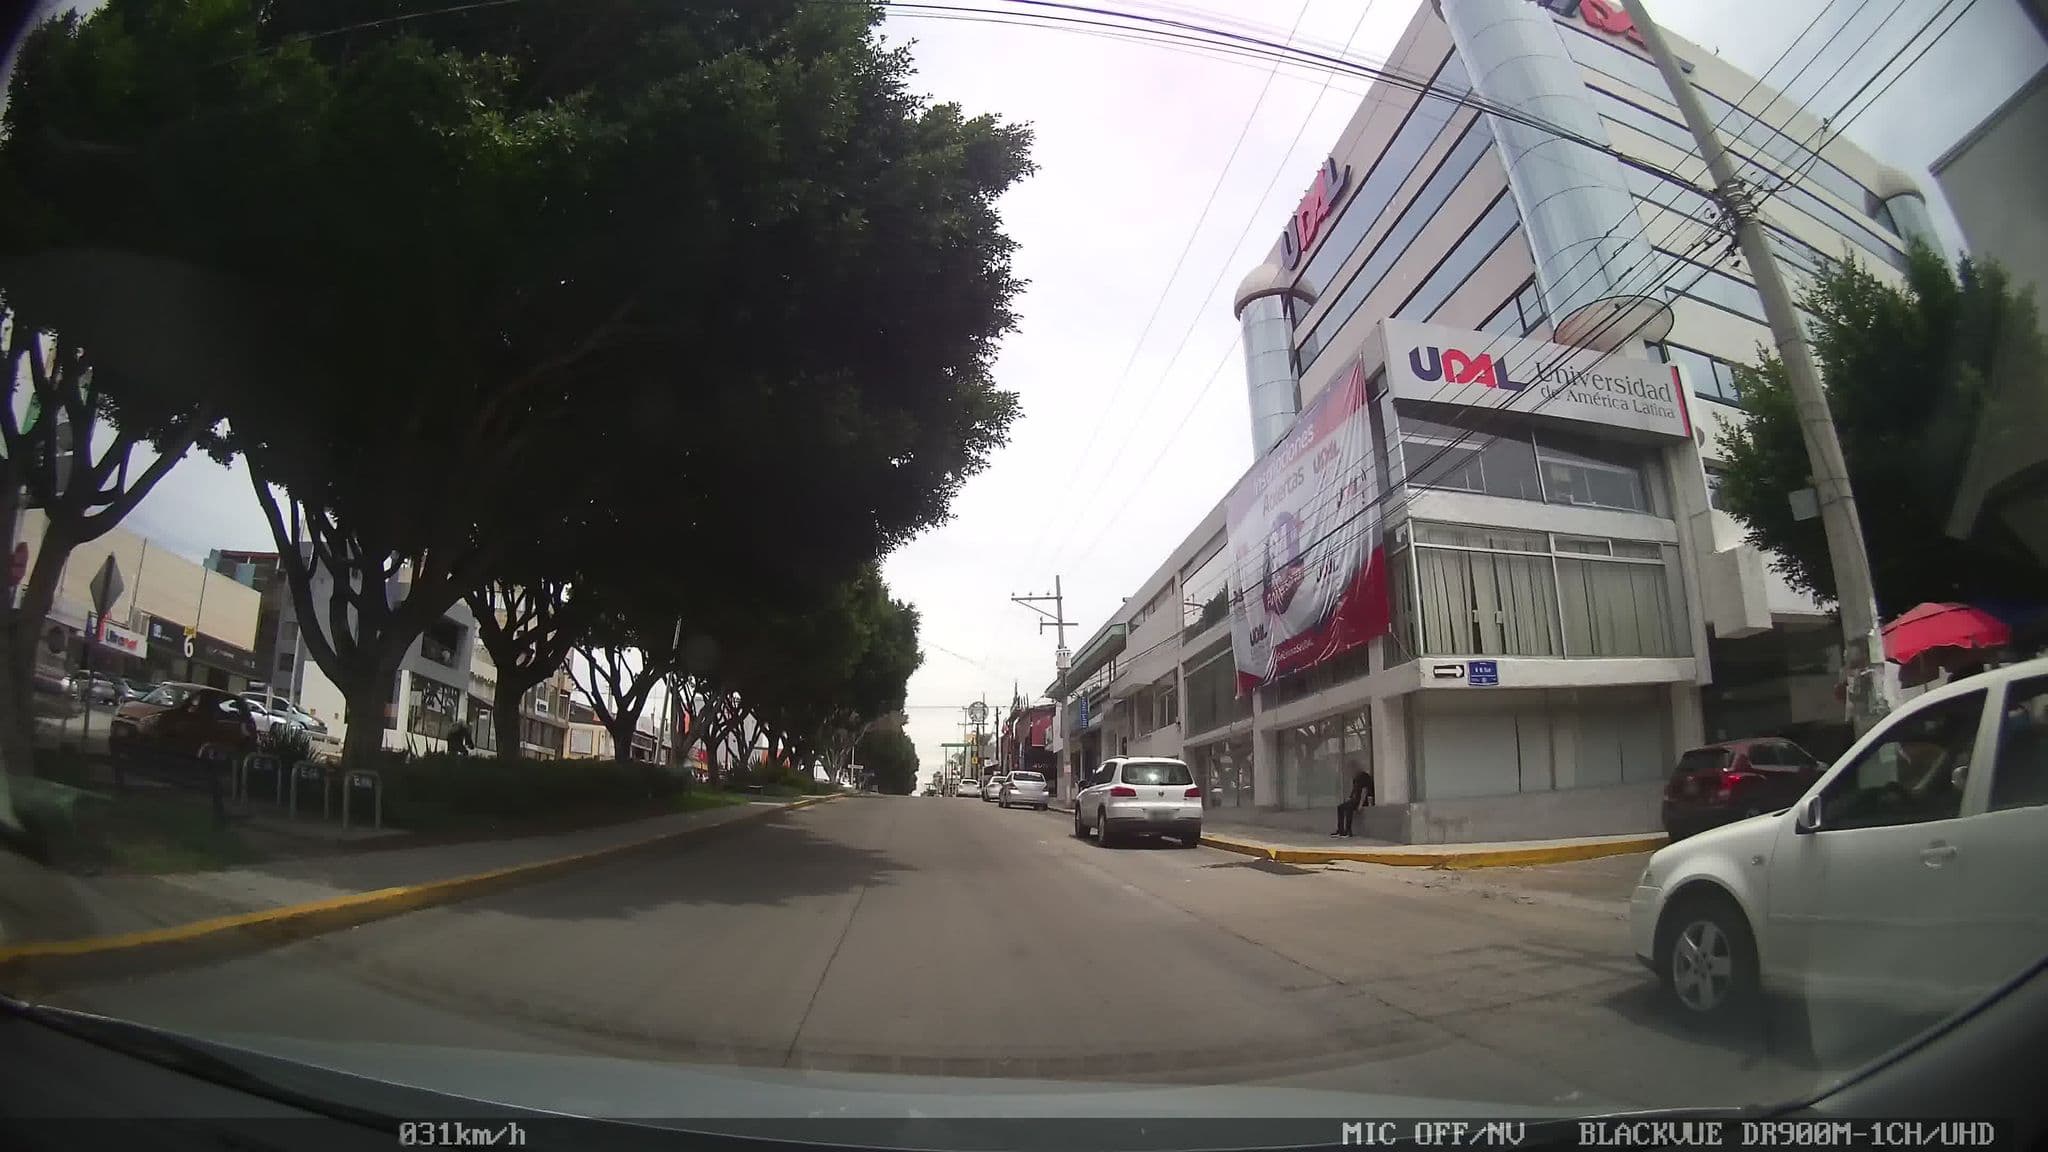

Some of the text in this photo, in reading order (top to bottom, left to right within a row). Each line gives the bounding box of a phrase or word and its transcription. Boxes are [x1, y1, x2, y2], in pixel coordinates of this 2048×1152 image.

[1280, 157, 1351, 271] UDAL
[1409, 346, 1528, 392] UDAL
[1535, 361, 1673, 403] Universidad
[1540, 384, 1676, 419] de América Latina
[183, 636, 195, 658] 6
